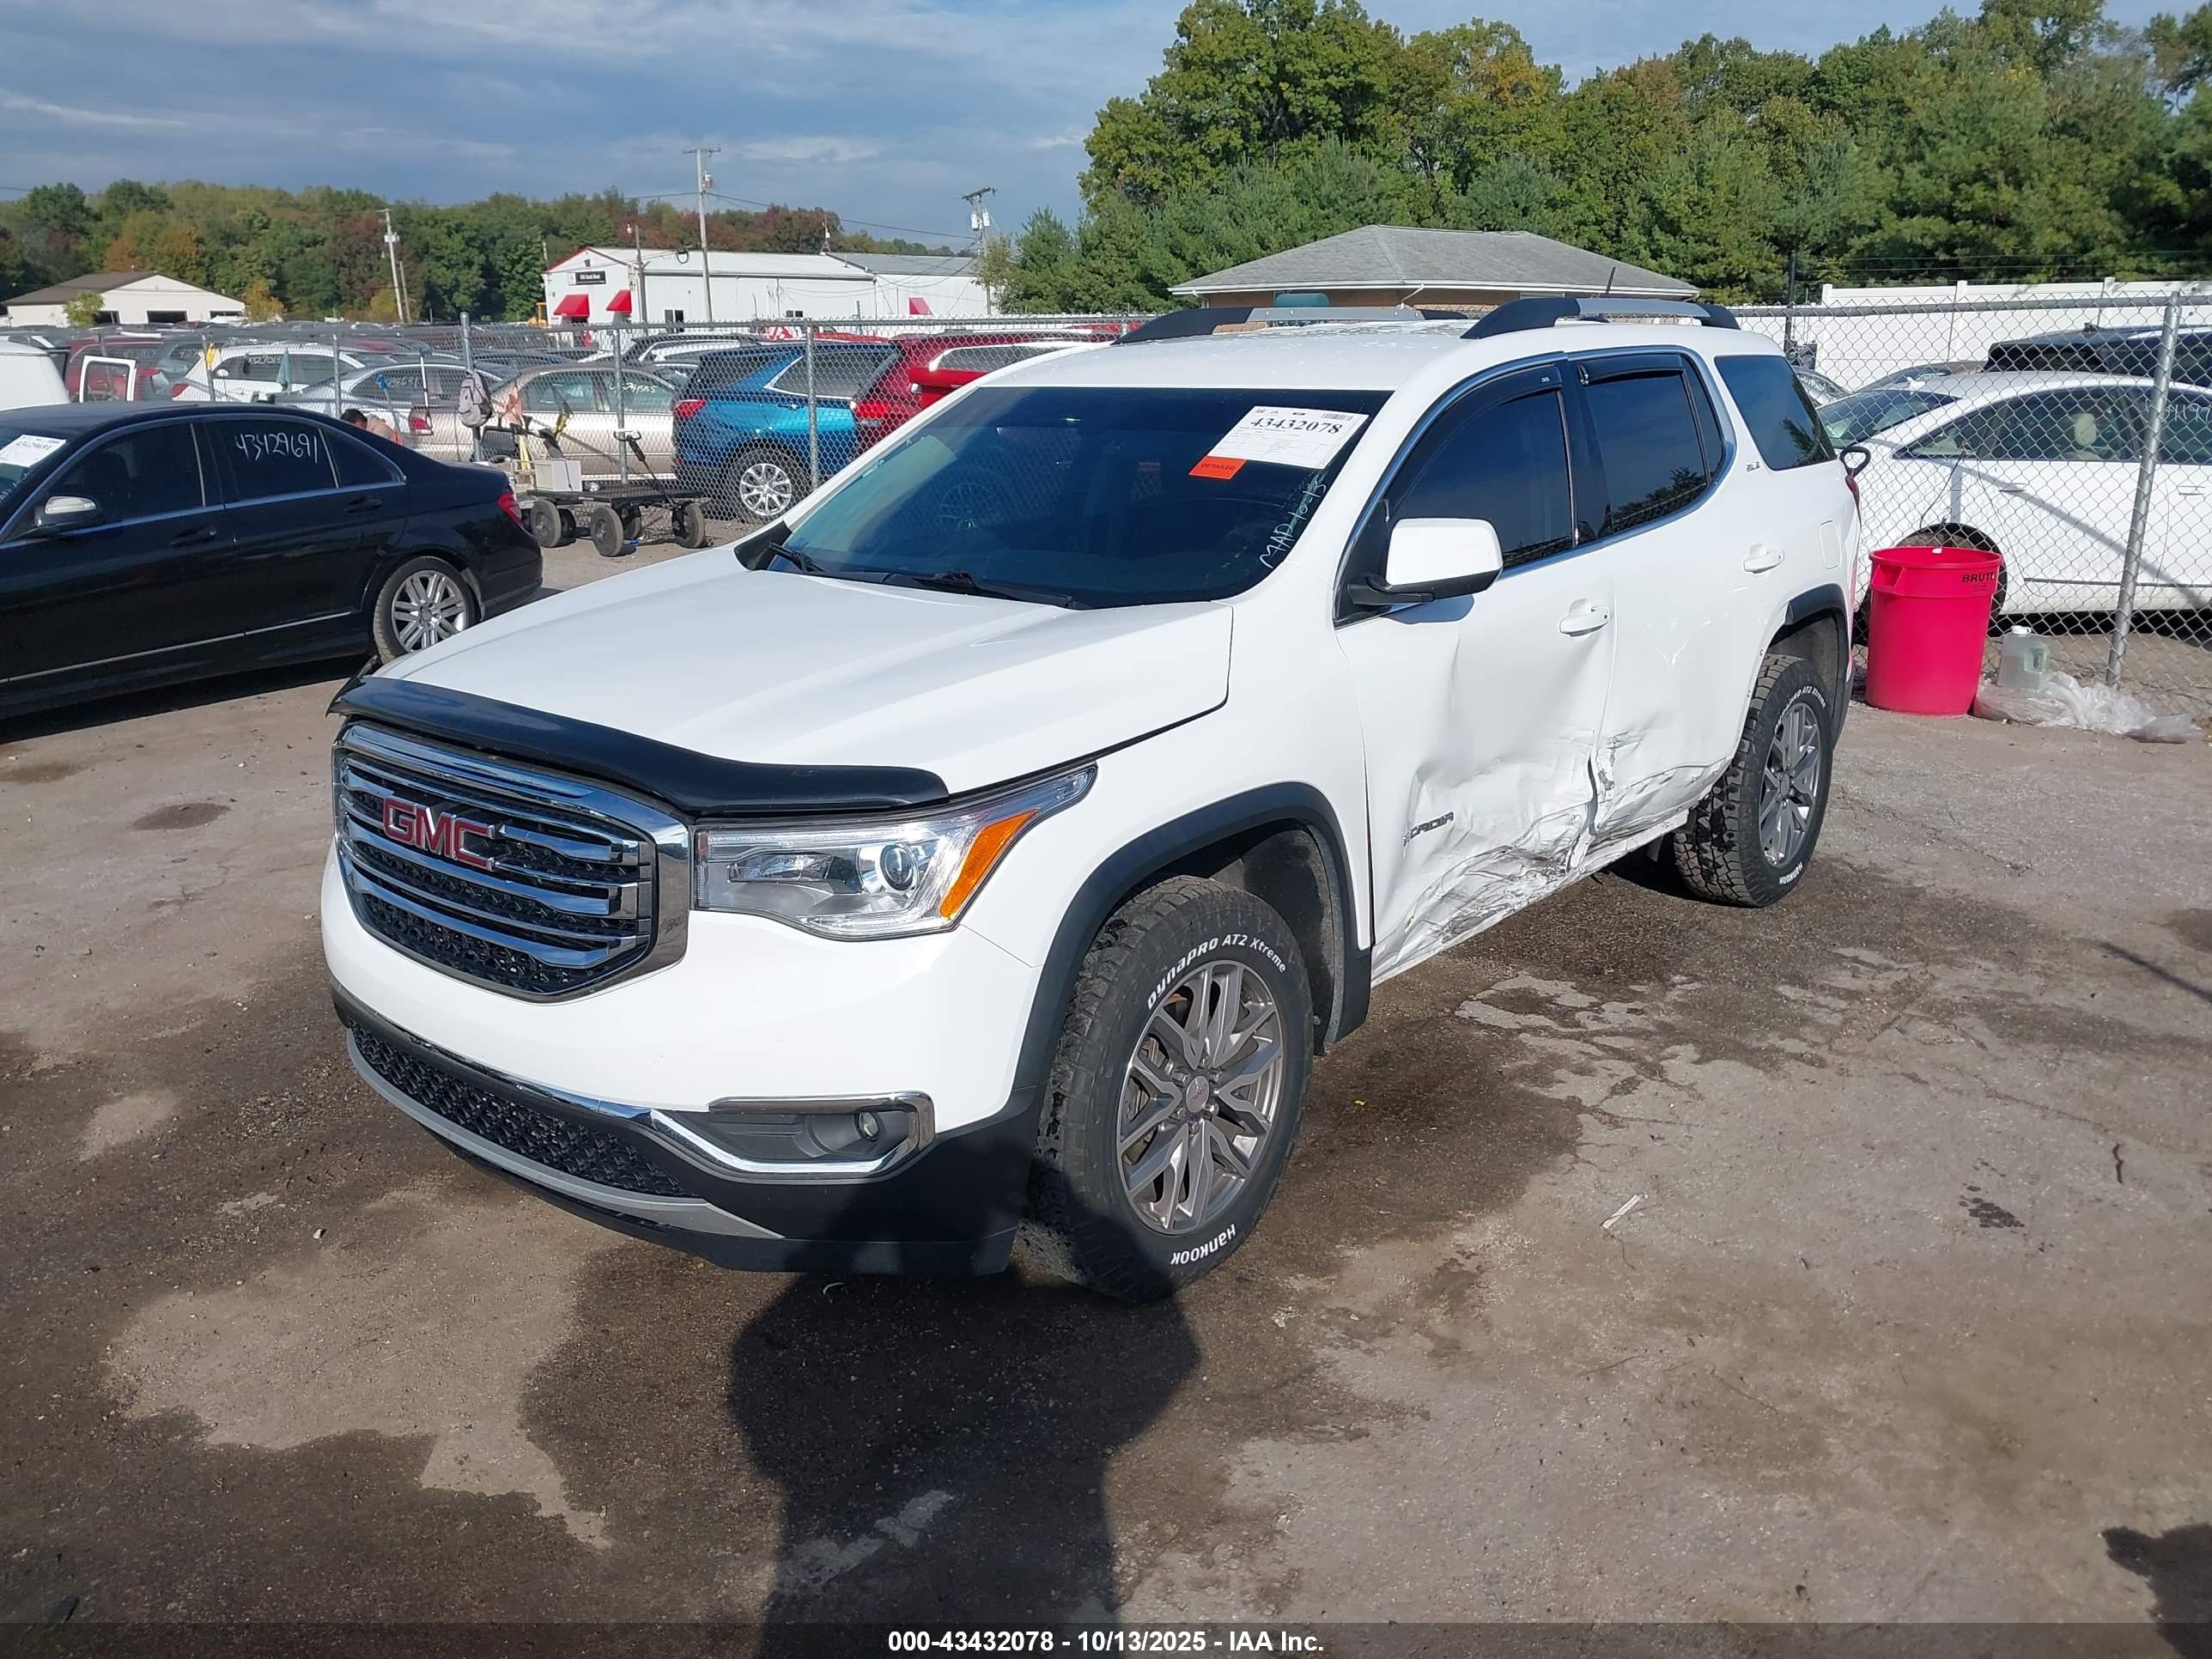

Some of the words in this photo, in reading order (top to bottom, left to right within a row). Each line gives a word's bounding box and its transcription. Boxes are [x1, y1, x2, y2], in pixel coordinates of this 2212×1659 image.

[1250, 417, 1343, 434] 43432078
[234, 432, 318, 465] 43429691
[1201, 463, 1237, 471] DETAILED
[383, 794, 495, 872] GMC
[1221, 933, 1249, 947] AT2
[1249, 937, 1287, 974] Xtreme
